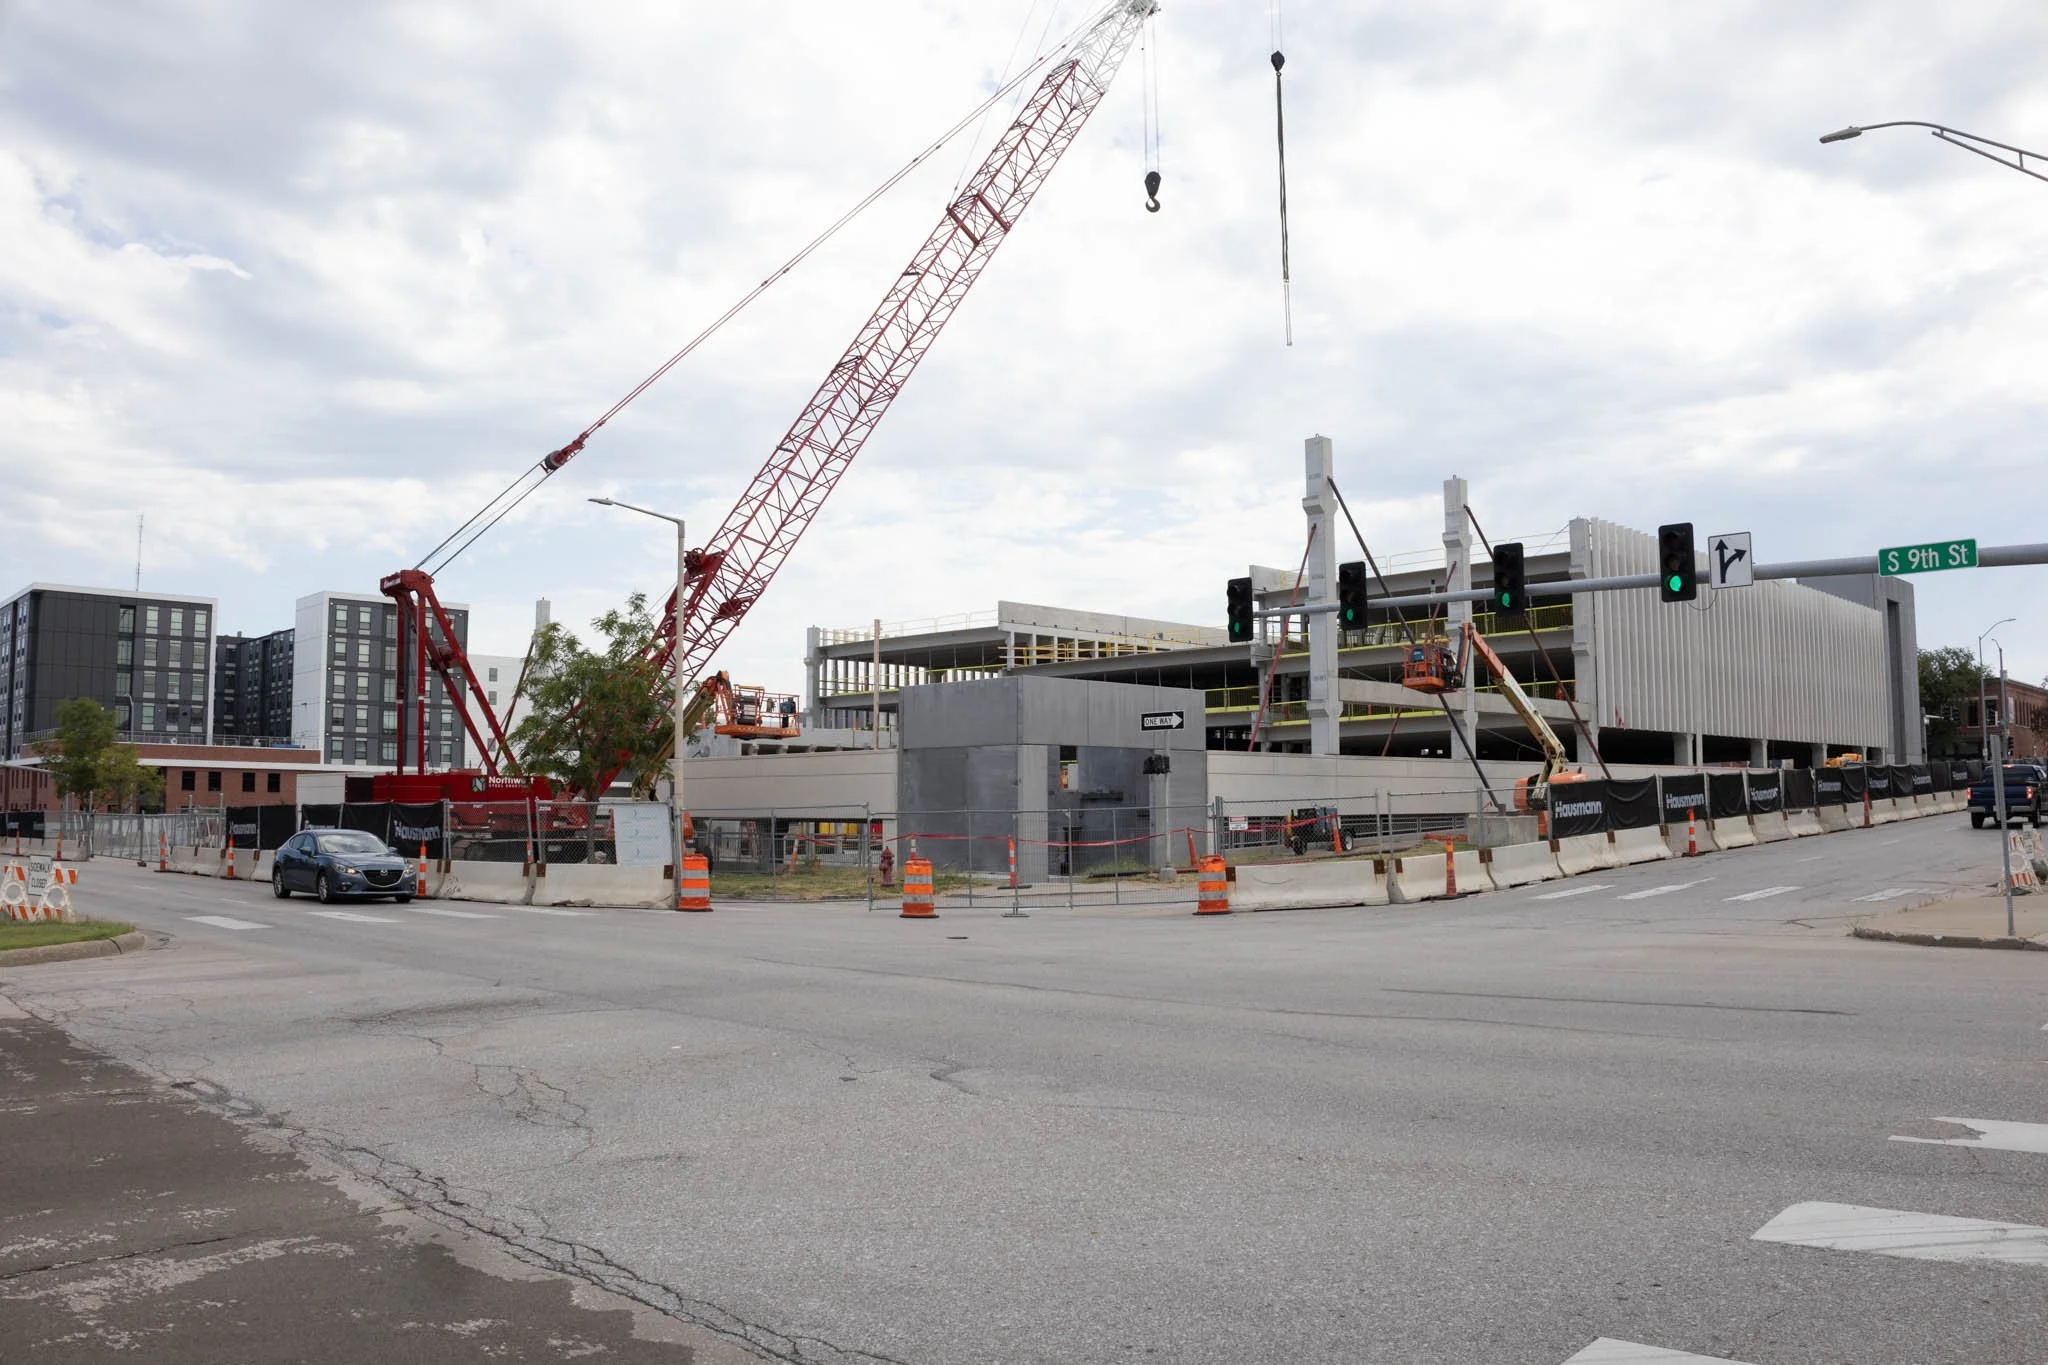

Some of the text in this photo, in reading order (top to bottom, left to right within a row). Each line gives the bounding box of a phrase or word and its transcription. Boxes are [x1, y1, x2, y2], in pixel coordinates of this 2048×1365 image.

[1887, 544, 1969, 572] S 9th St
[1160, 717, 1172, 725] WAY
[488, 775, 536, 784] Northwet
[1666, 793, 1705, 809] Hausmann
[1555, 801, 1602, 819] Hausmann
